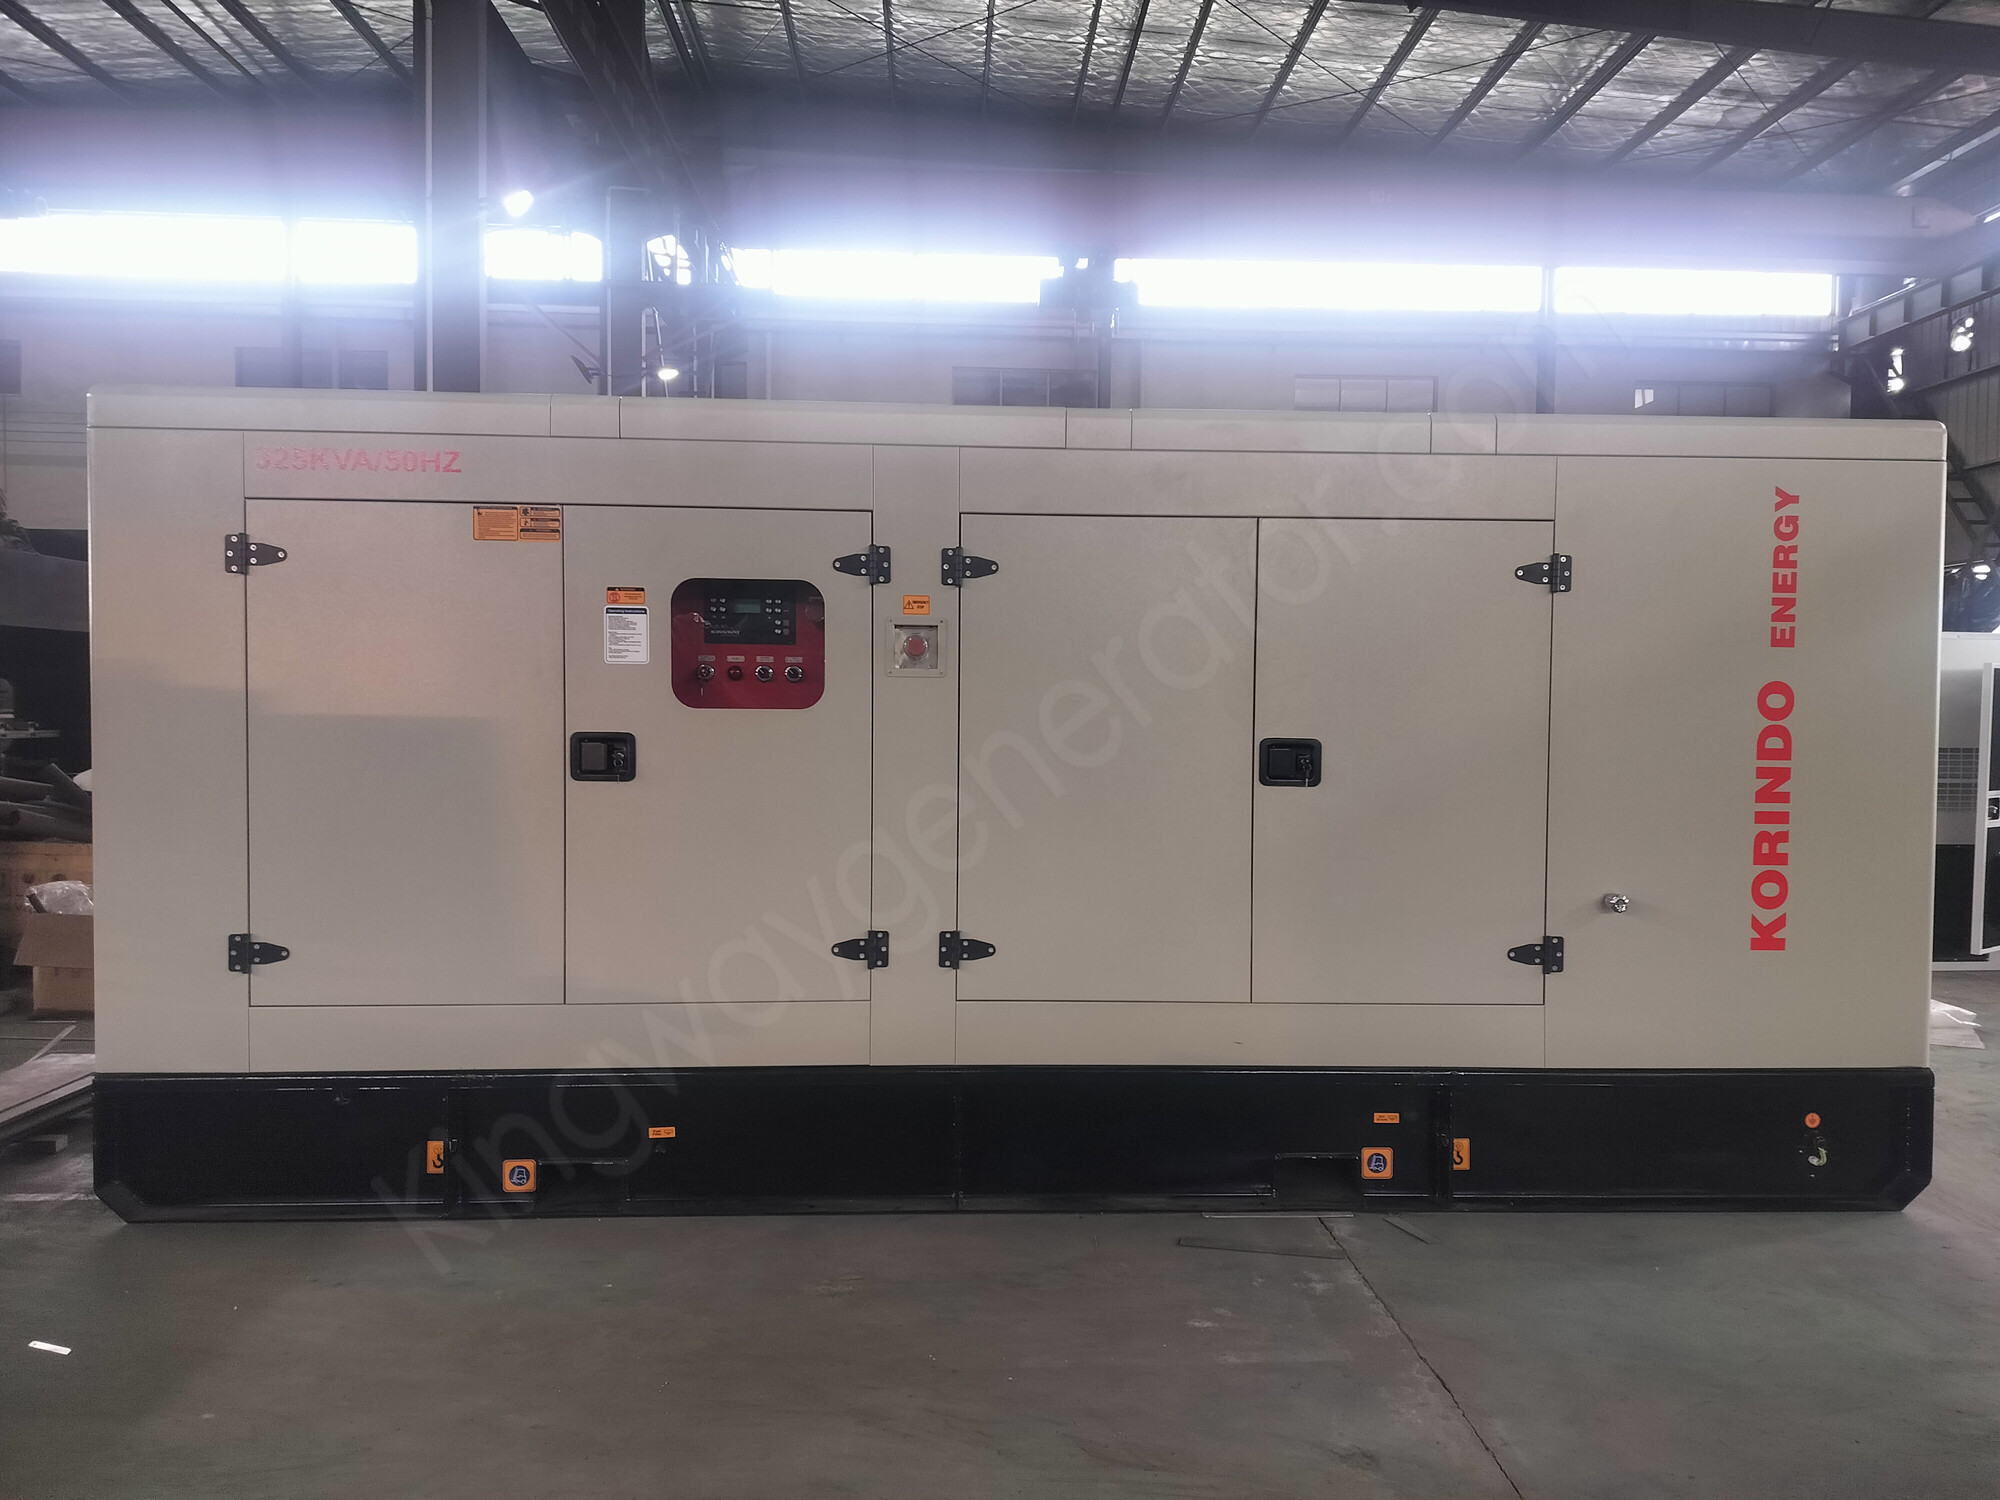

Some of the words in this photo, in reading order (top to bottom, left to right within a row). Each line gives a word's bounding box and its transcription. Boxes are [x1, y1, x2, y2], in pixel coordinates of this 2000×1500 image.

[256, 447, 463, 473] 325KVA/50HZ
[1769, 485, 1801, 648] ENERGY
[1749, 680, 1796, 952] KORINDO
